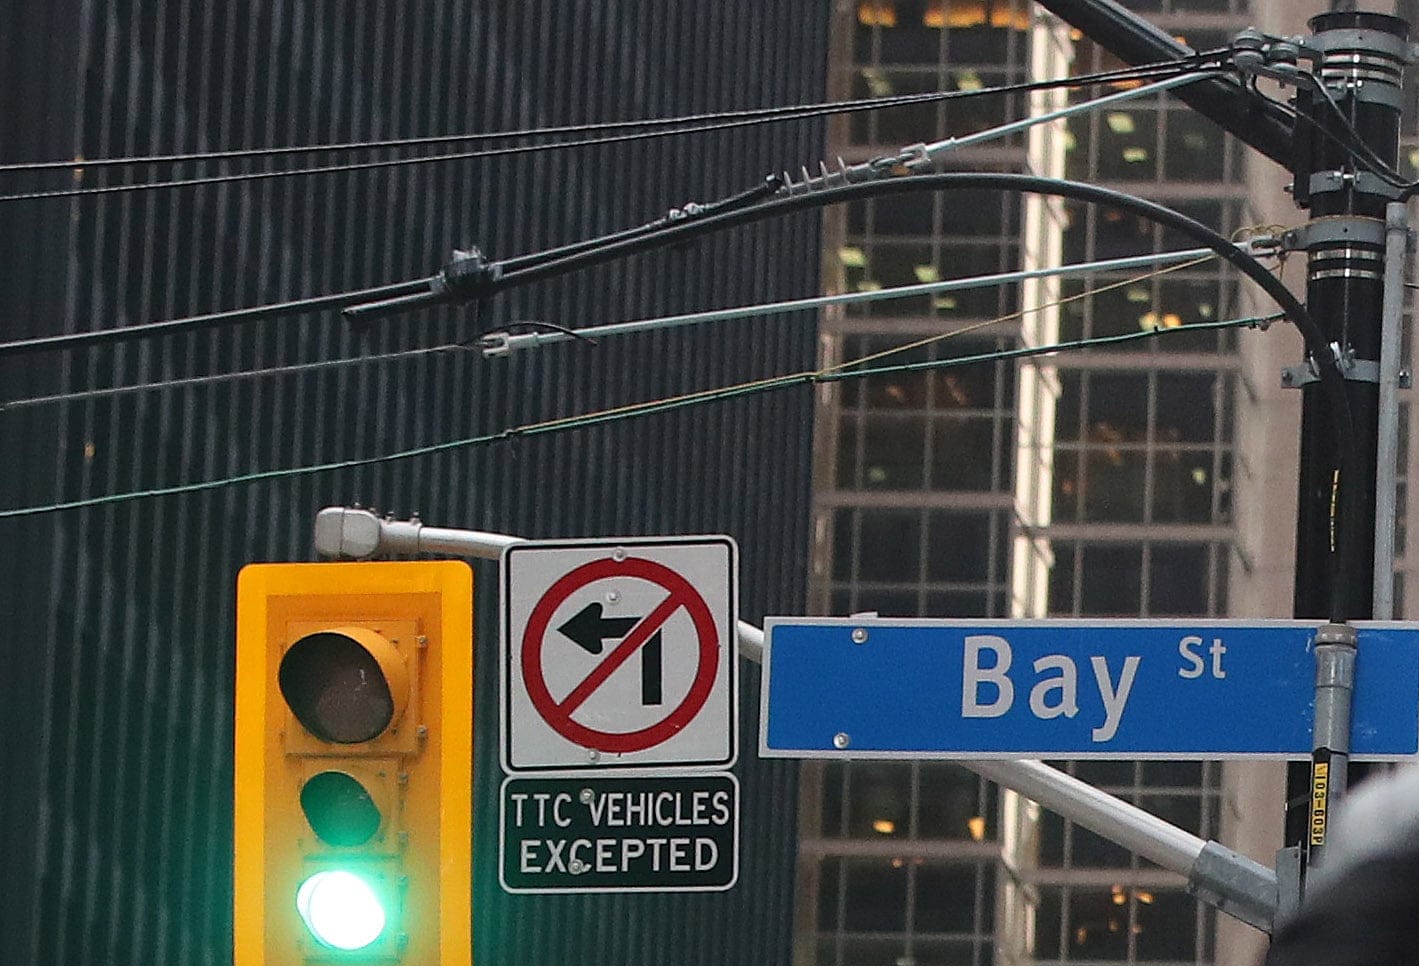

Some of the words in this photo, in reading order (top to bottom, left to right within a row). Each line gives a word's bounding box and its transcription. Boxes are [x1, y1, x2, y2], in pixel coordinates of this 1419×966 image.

[961, 635, 1141, 742] Bay
[1178, 635, 1227, 679] St
[511, 792, 572, 828] TTC
[586, 790, 730, 827] VEHICLES
[520, 837, 719, 874] EXCEPTED
